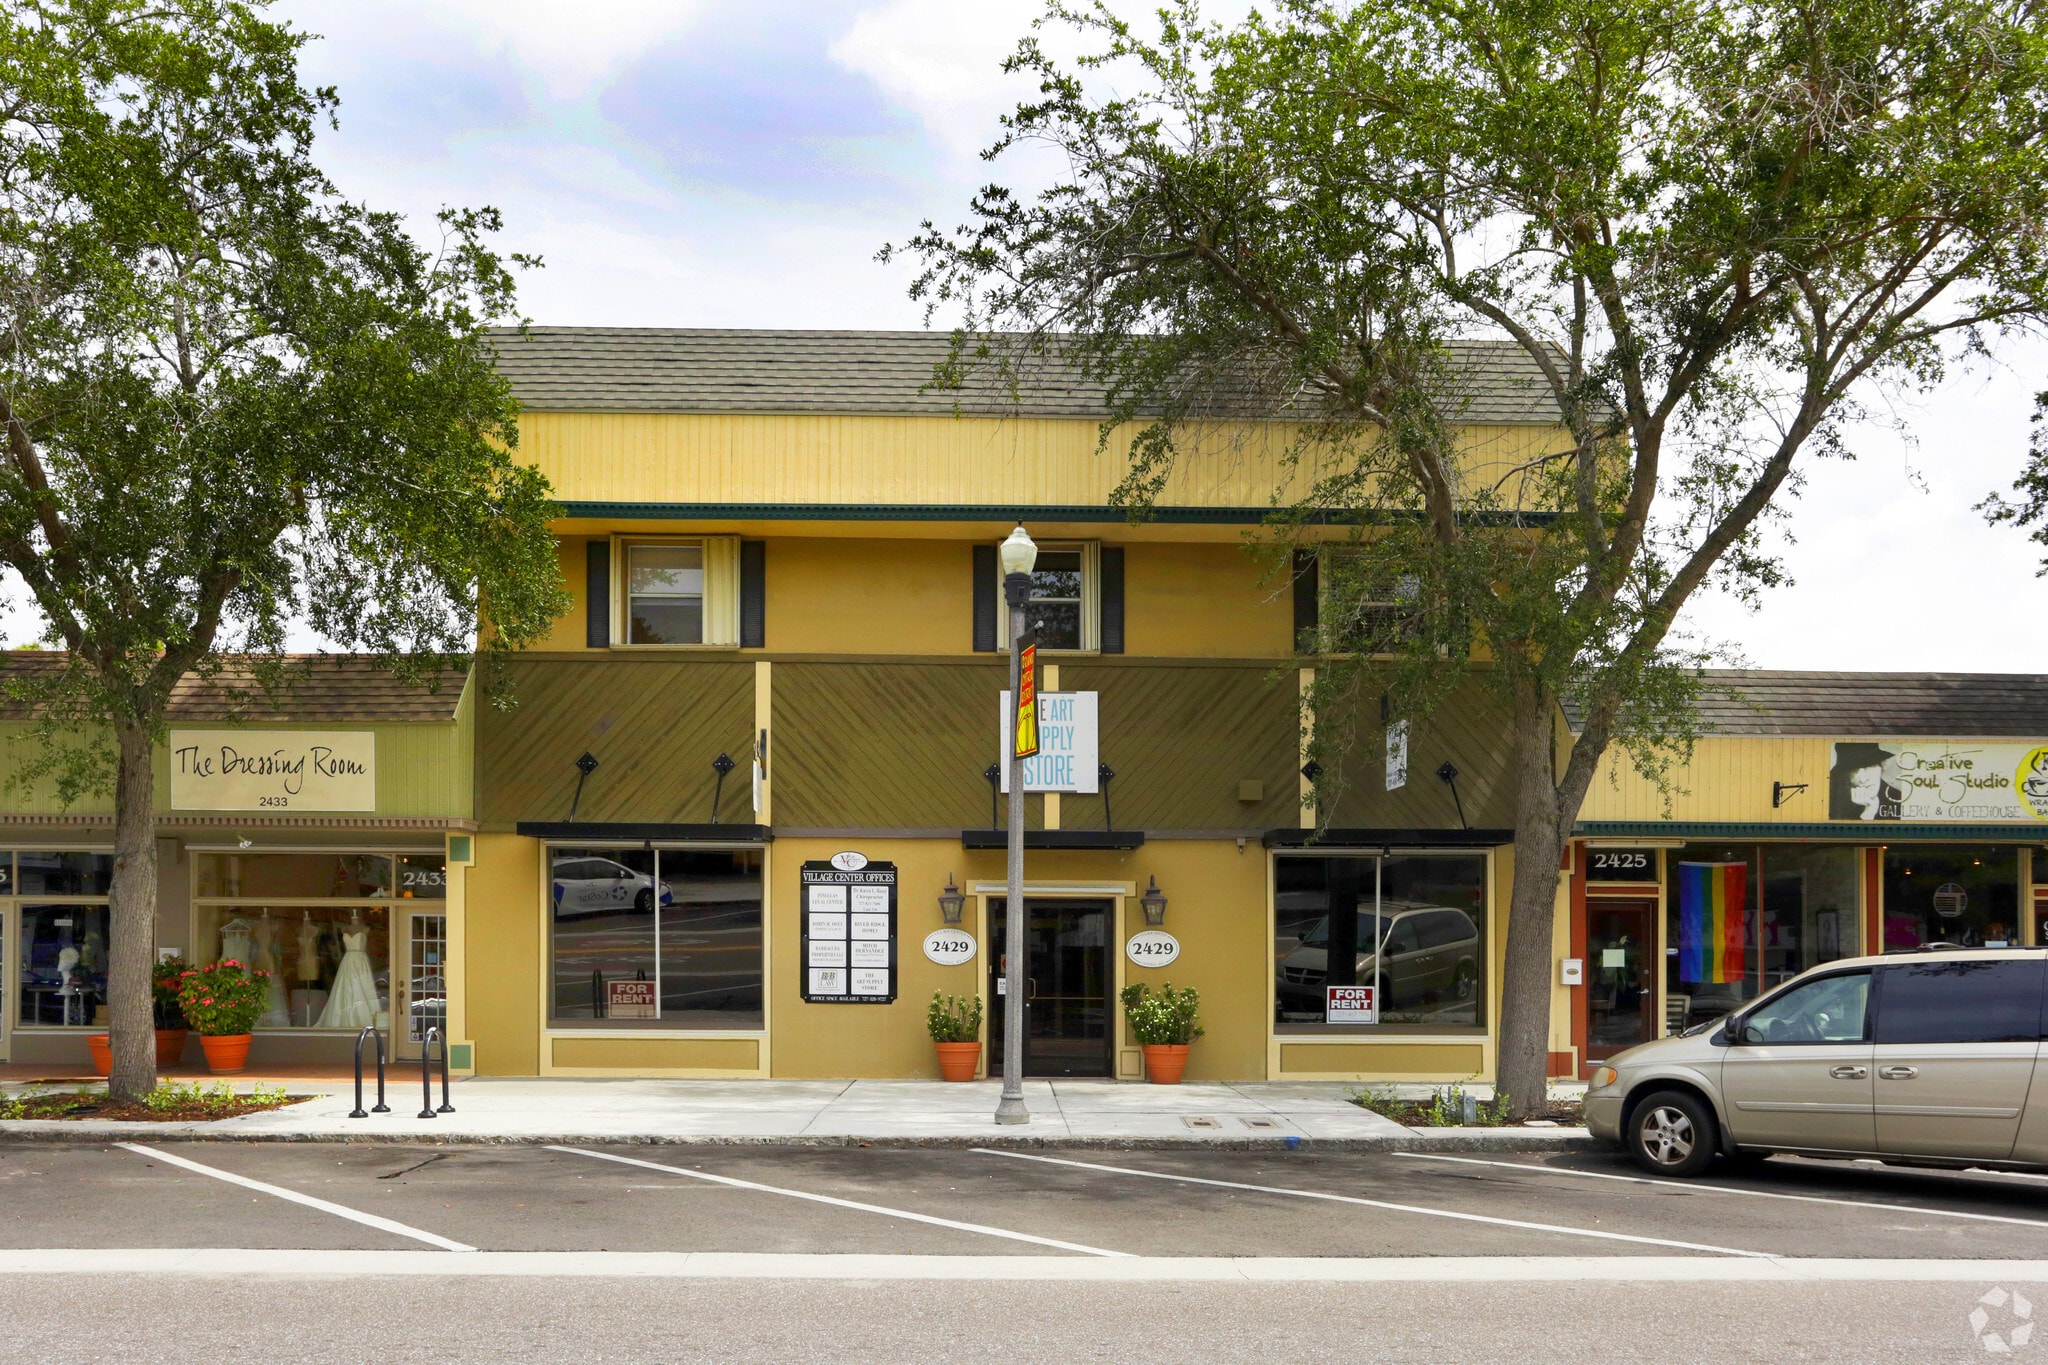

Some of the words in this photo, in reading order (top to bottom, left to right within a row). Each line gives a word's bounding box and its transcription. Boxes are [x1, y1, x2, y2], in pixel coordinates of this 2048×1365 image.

[1051, 699, 1075, 722] ART
[1041, 726, 1075, 750] PPLY
[175, 745, 215, 777] The
[220, 746, 306, 795] Dressing
[310, 746, 368, 778] Room
[1024, 755, 1075, 786] STORE
[1938, 772, 2009, 804] Studio
[259, 797, 288, 807] 2433
[1879, 805, 1930, 818] GALLERY
[1935, 806, 1943, 817] &
[1948, 805, 2021, 818] COFFEEHOUSE
[1594, 853, 1647, 868] 2425
[803, 872, 833, 882] VILLAGE
[834, 873, 865, 882] CENTER
[865, 873, 895, 883] OFFICES
[932, 940, 969, 952] 2429
[1133, 942, 1174, 955] 2429
[616, 984, 648, 994] FOR
[1335, 989, 1366, 999] FOR
[612, 994, 653, 1004] RENT
[1331, 999, 1371, 1009] RENT
